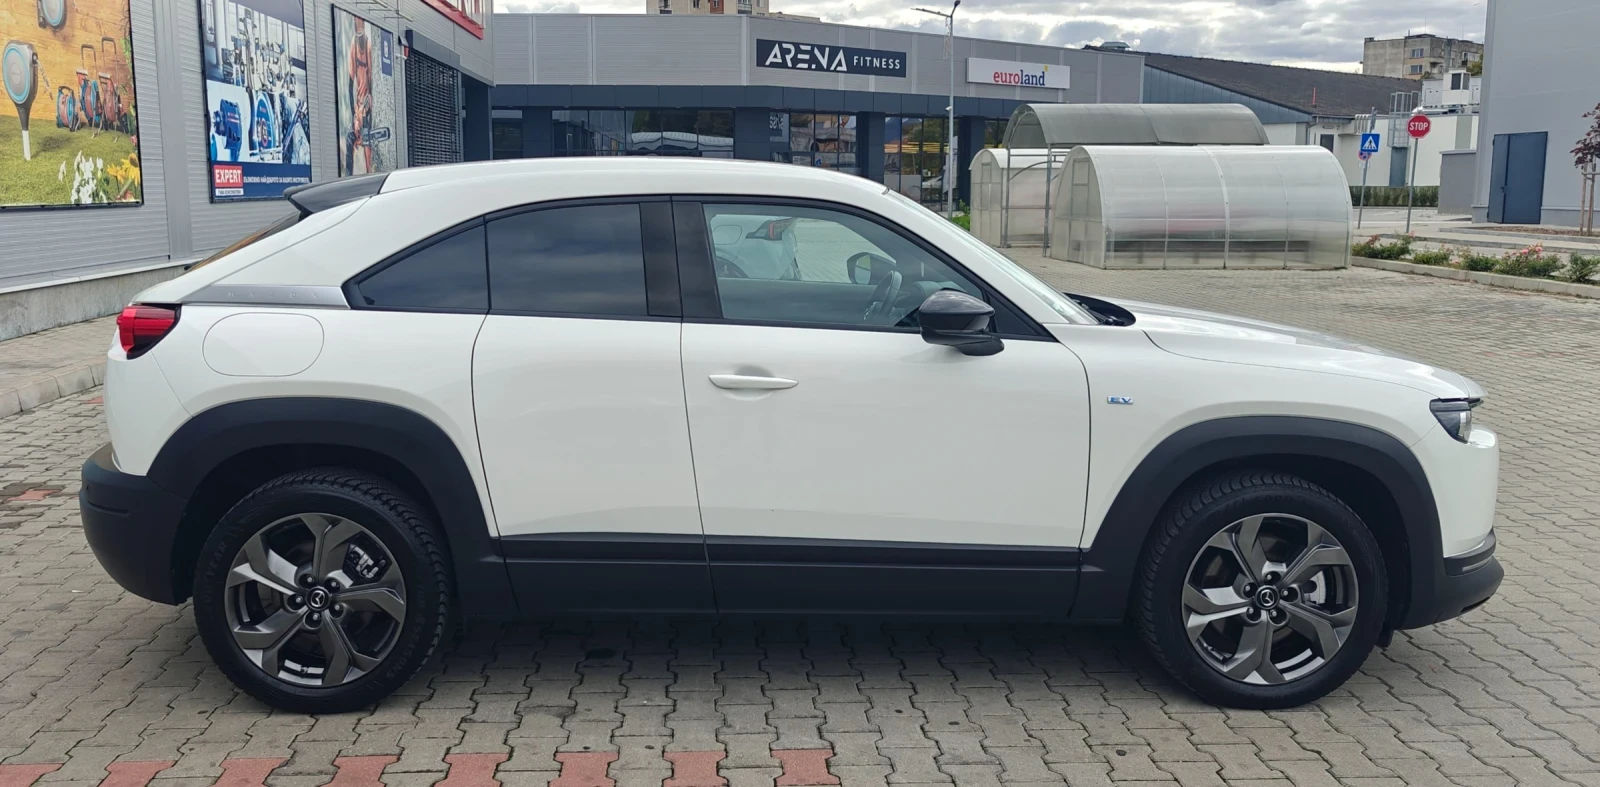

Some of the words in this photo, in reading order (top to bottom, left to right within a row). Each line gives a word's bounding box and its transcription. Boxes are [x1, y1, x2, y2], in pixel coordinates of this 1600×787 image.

[765, 42, 848, 72] ARENA
[853, 55, 901, 70] FITNESS
[993, 69, 1046, 86] euroland
[1409, 122, 1428, 131] STOP
[215, 169, 242, 184] EXPERT
[1108, 396, 1133, 404] EV
